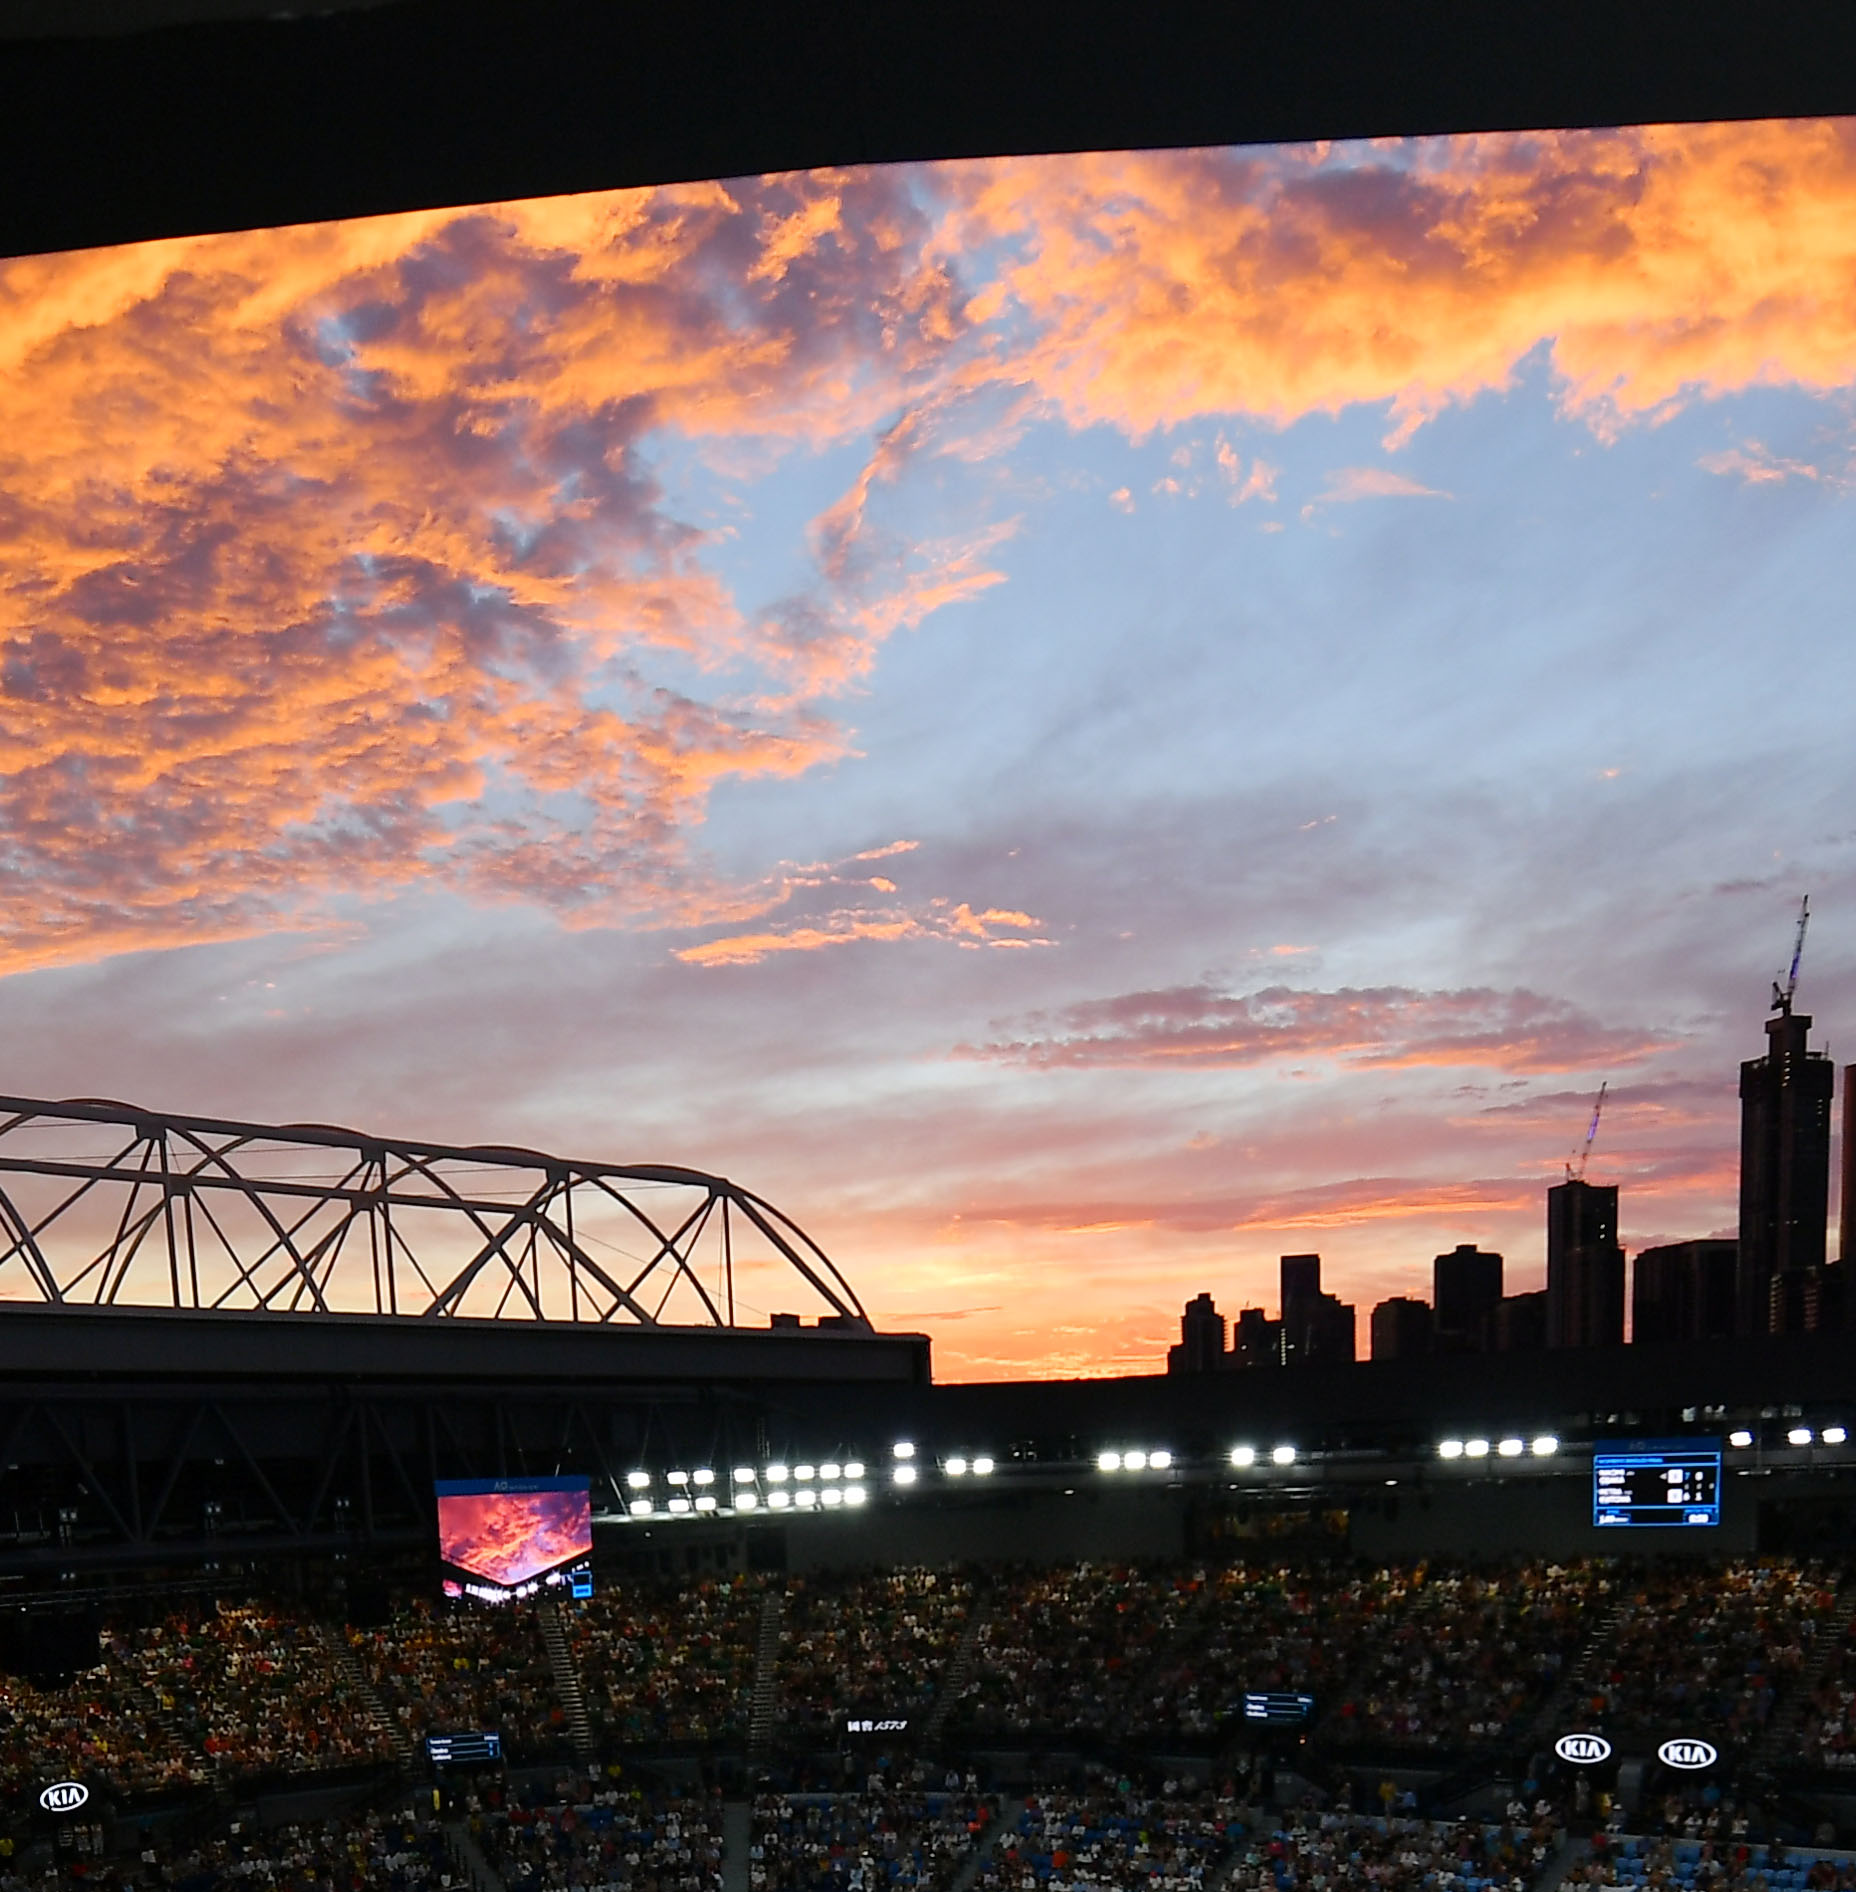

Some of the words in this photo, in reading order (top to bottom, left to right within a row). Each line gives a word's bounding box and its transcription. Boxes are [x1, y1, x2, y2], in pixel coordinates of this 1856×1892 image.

[1564, 1741, 1602, 1757] KIA
[1668, 1745, 1706, 1762] KIA
[48, 1788, 81, 1807] KIA
